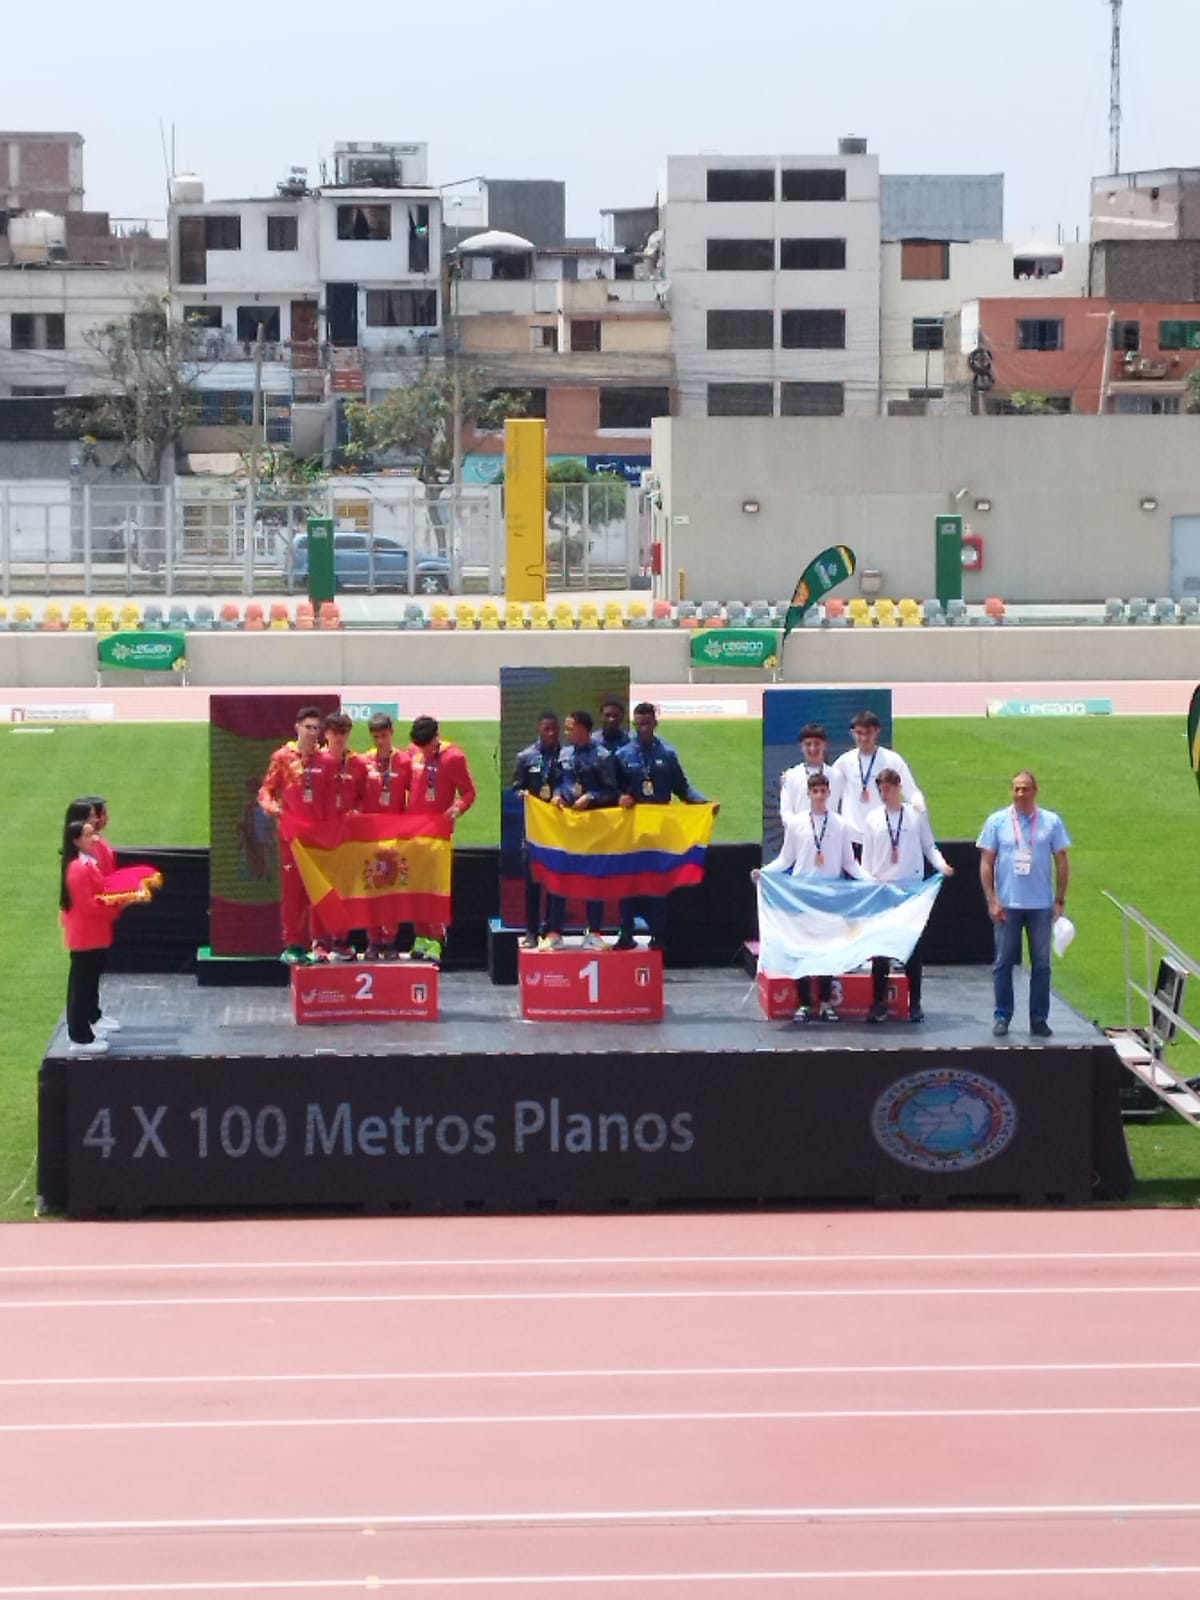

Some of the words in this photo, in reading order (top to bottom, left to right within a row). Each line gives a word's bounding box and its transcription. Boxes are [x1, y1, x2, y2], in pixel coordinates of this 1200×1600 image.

[354, 972, 374, 1000] 2
[578, 960, 599, 1003] 1
[83, 1107, 116, 1158] 4
[189, 1104, 287, 1157] 100
[304, 1102, 496, 1156] Metros
[514, 1097, 695, 1152] Planos
